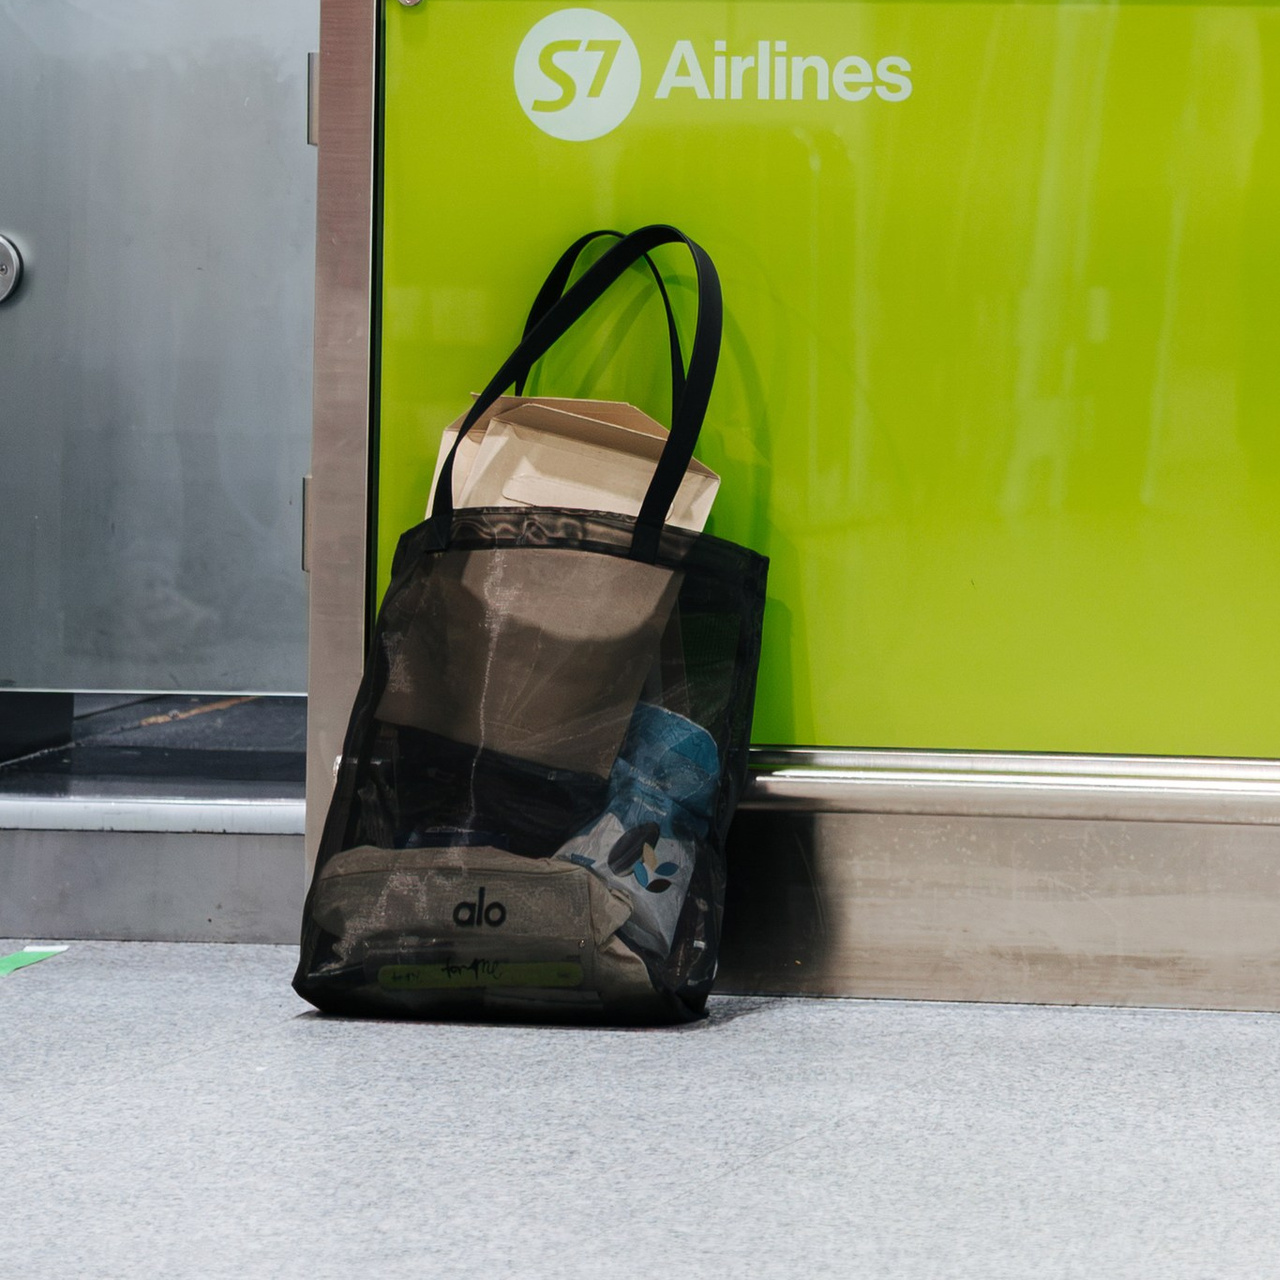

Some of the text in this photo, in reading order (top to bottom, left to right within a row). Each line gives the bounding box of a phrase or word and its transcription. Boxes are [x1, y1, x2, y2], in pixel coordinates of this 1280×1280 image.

[530, 38, 914, 113] S7 Airlines
[452, 886, 507, 928] alo
